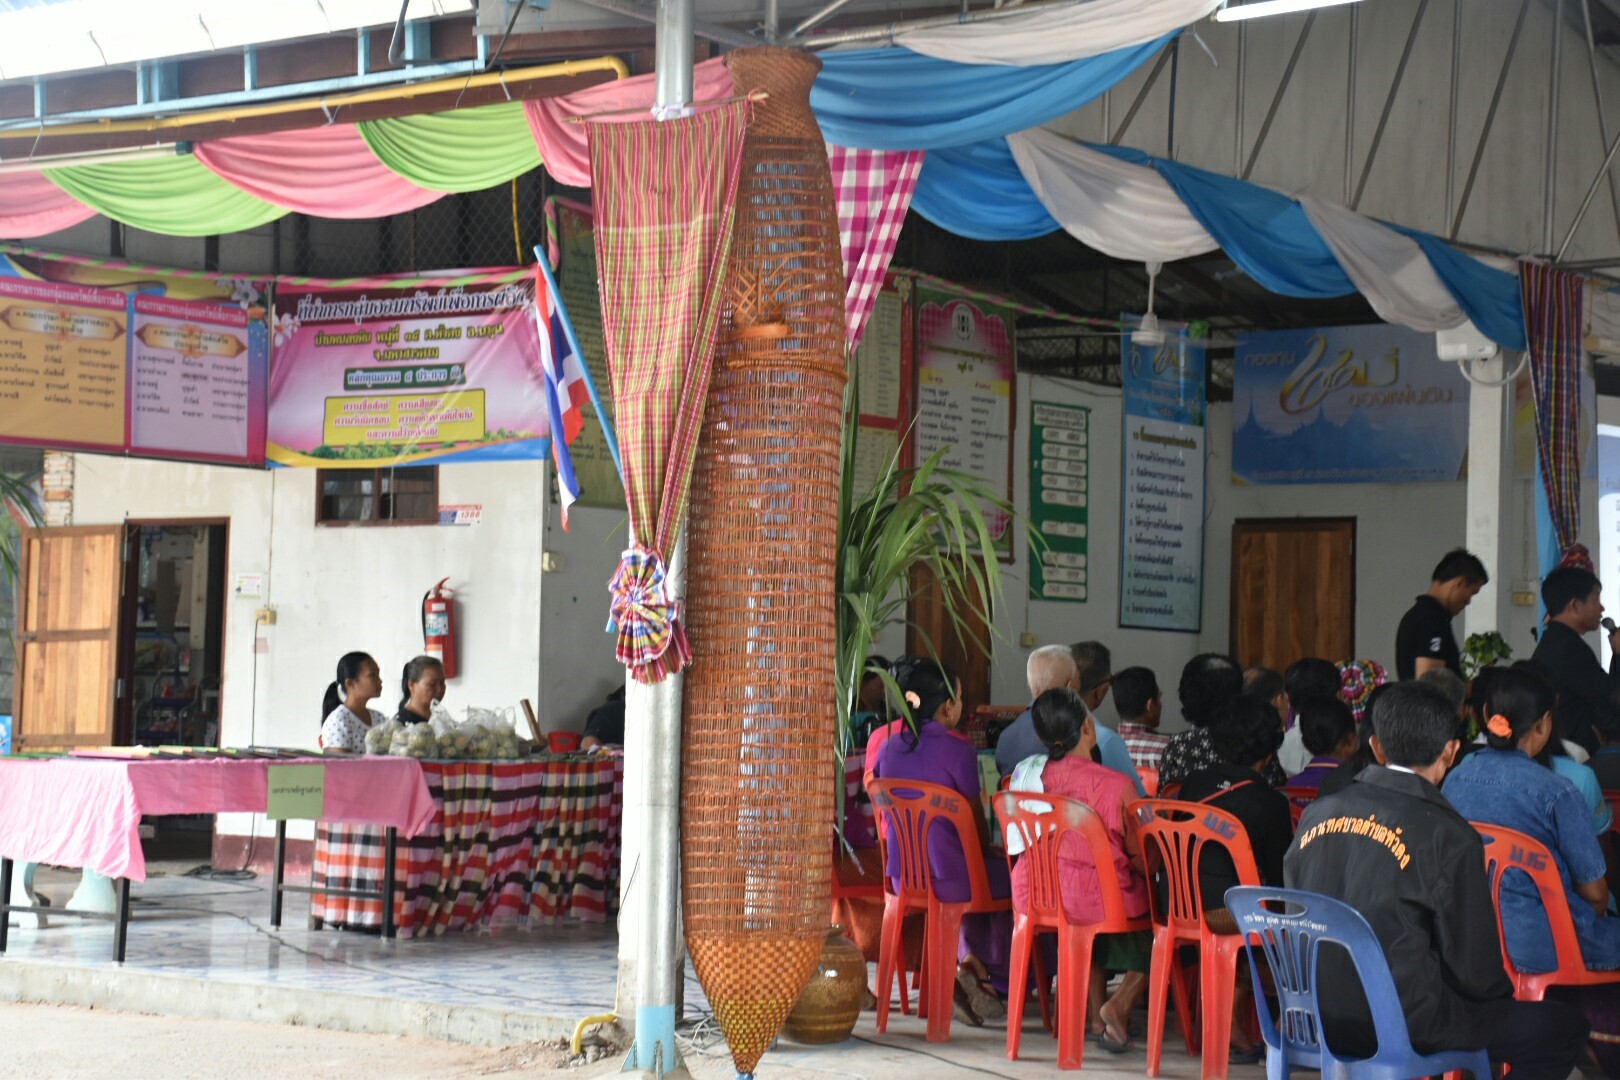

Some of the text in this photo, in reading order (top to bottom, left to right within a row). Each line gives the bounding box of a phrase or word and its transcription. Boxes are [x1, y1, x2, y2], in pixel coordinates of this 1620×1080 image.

[297, 286, 527, 324] ที่ทำการกลุ่มออมทรัพย์เพื่อการผลิต
[376, 325, 400, 347] หมู่ที่
[374, 346, 439, 362] จ.มหาสารคาม
[1244, 351, 1298, 367] กองทุน
[347, 370, 401, 388] หลักคุณธรรม
[415, 368, 448, 383] ประการ
[1348, 384, 1453, 408] ของแผ่นดิน
[1299, 813, 1411, 871] สภาเทศบาลตำบลหัวดง
